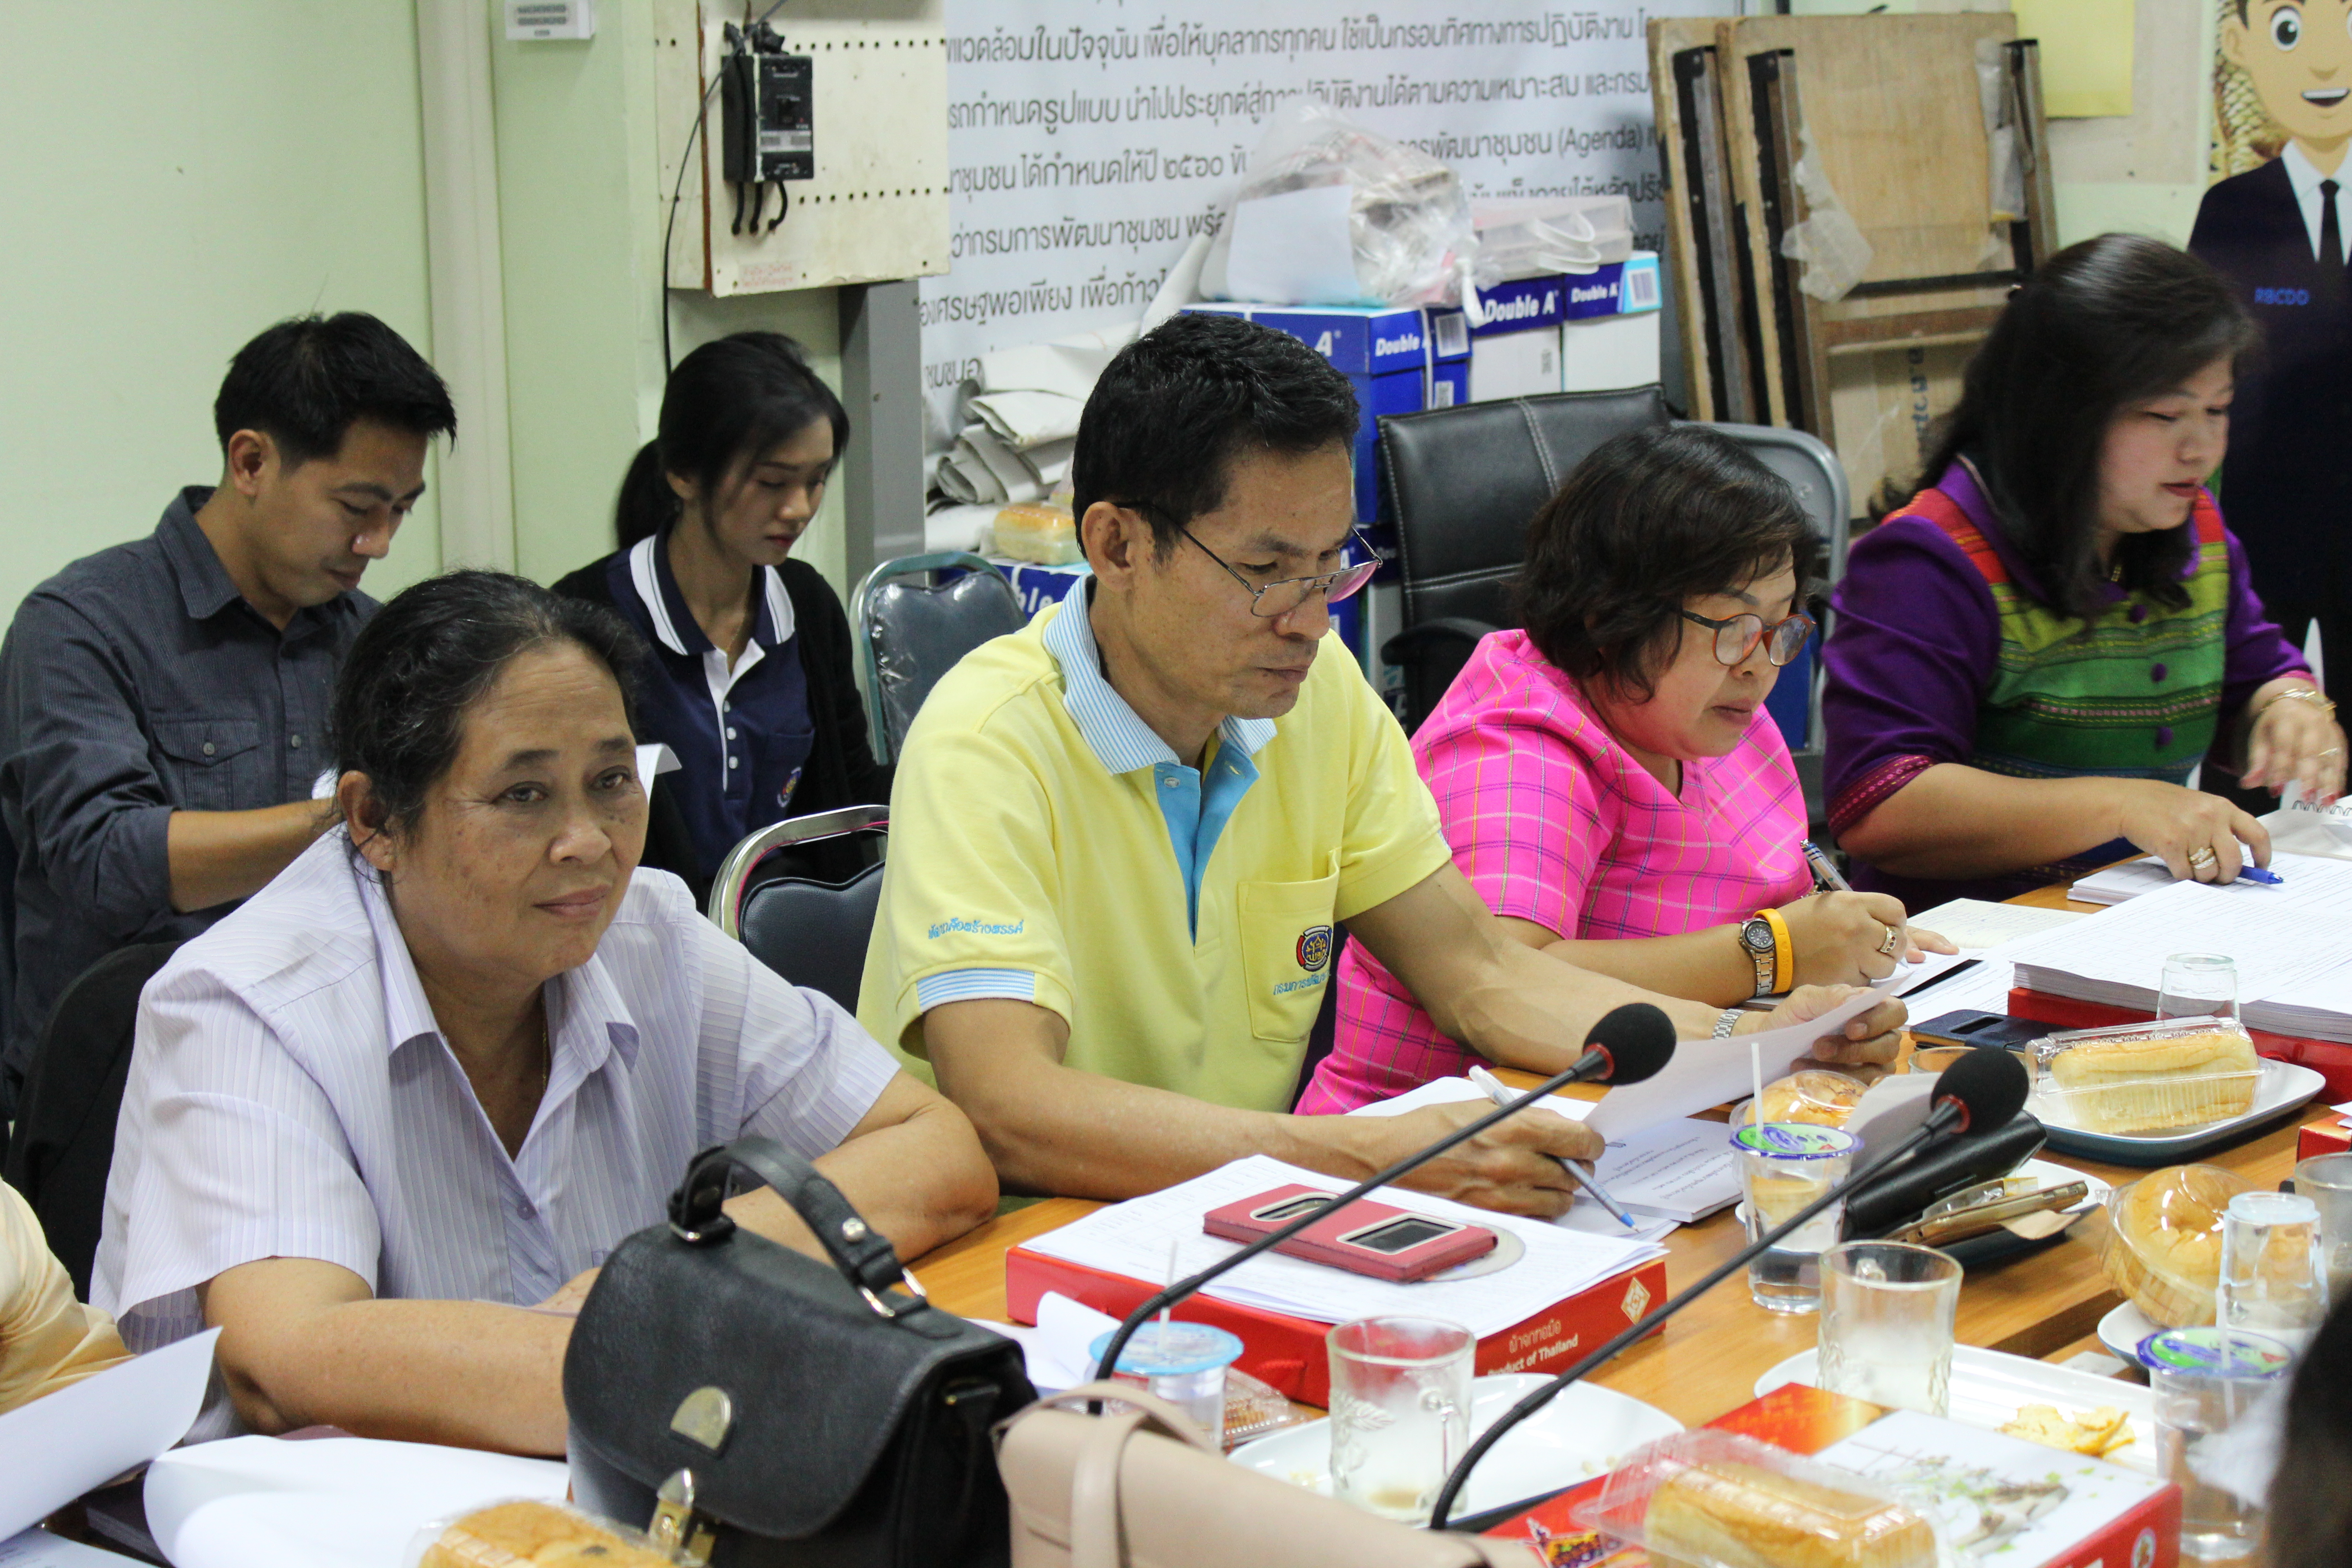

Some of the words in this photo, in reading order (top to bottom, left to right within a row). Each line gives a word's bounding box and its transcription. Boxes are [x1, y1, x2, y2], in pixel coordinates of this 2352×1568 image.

[949, 163, 1016, 204] าชุมชน
[1558, 123, 1642, 159] (Agenda)
[1485, 293, 1539, 323] Double
[1542, 290, 1555, 315] A
[1570, 284, 1608, 303] Double
[1608, 281, 1618, 298] A
[1375, 332, 1421, 357] Double
[1526, 1350, 1538, 1367] of
[1538, 1333, 1579, 1362] Thailand
